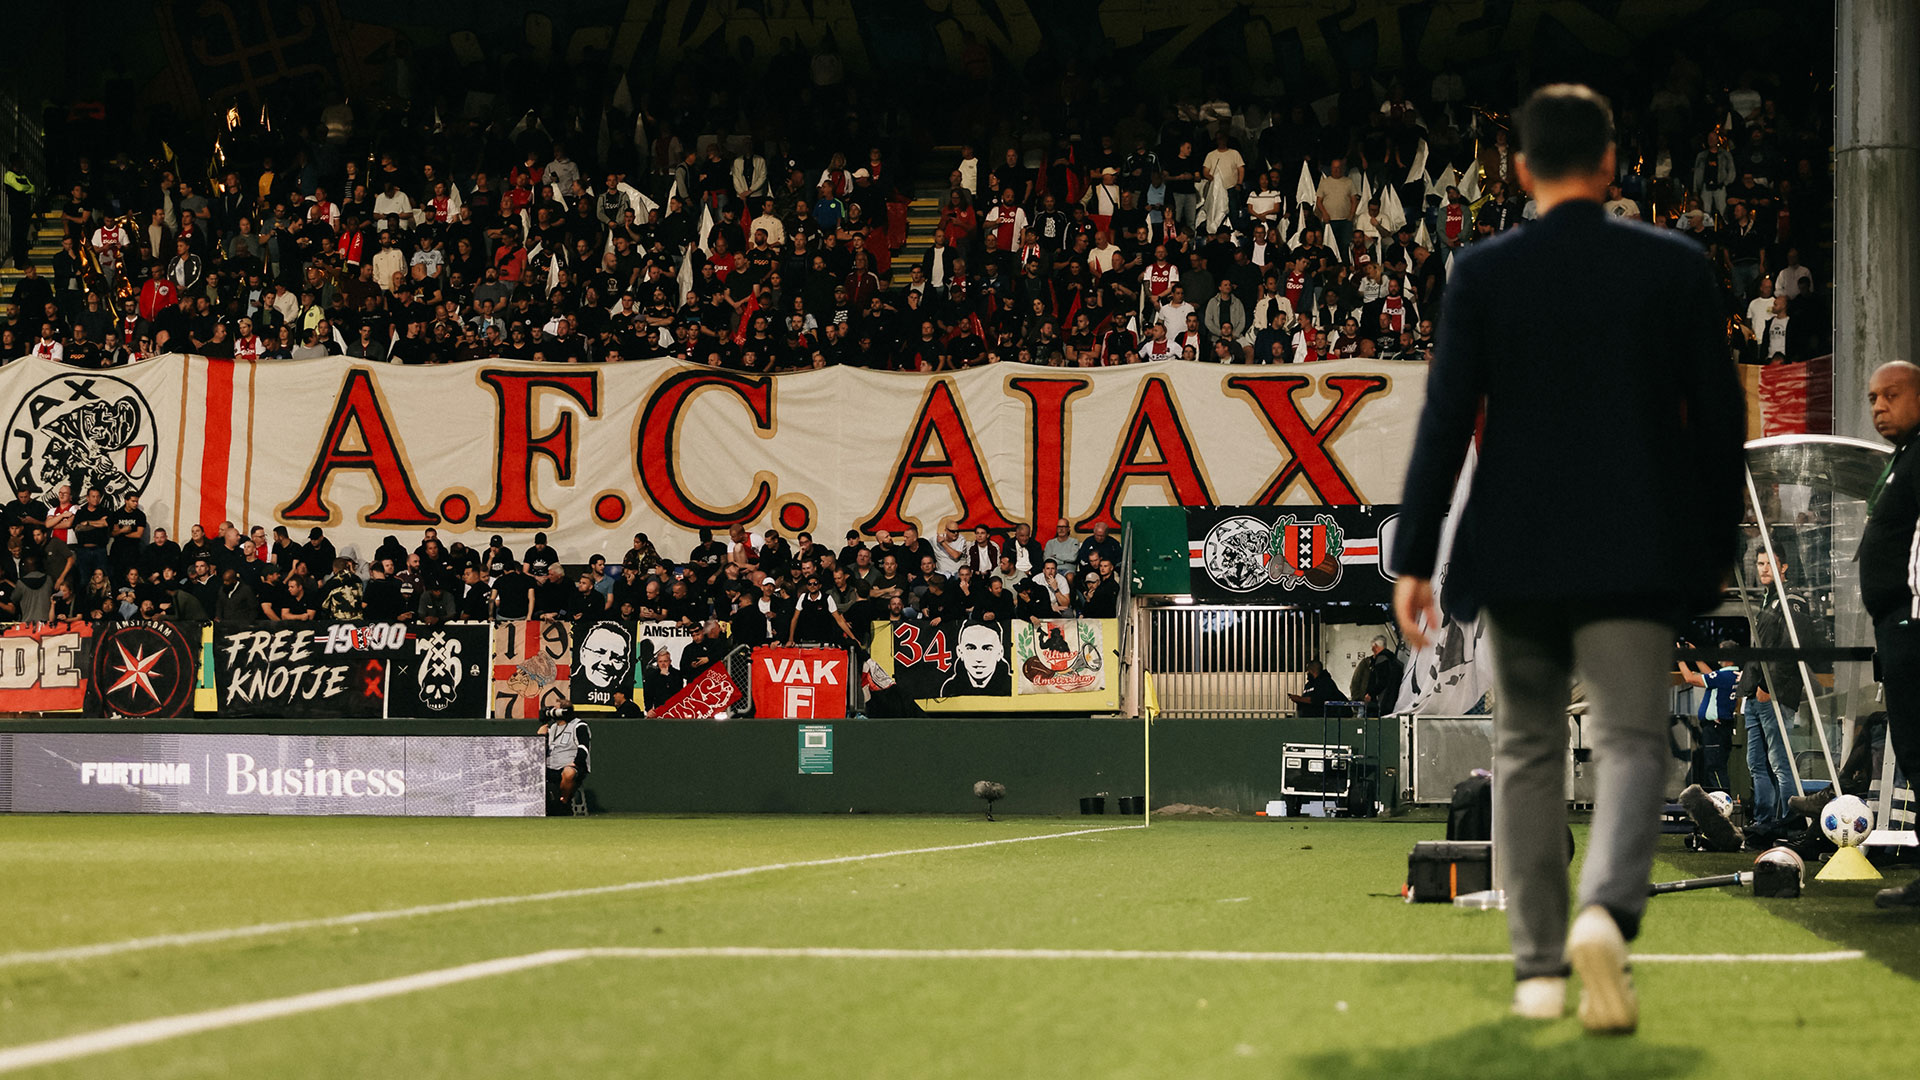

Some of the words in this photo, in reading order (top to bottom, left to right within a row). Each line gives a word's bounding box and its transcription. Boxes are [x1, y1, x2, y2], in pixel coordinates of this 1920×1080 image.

[14, 379, 101, 493] AJAX
[280, 368, 812, 533] A.F.C.
[857, 376, 1390, 550] AJAX
[222, 629, 315, 666] FREE
[895, 622, 952, 672] 34
[226, 664, 350, 706] KNOTJE
[763, 658, 840, 685] VAK
[1033, 673, 1096, 686] Amsterdam
[587, 688, 611, 704] sjap
[787, 692, 810, 719] F
[81, 762, 190, 785] FORTUNA
[226, 753, 405, 797] Business
